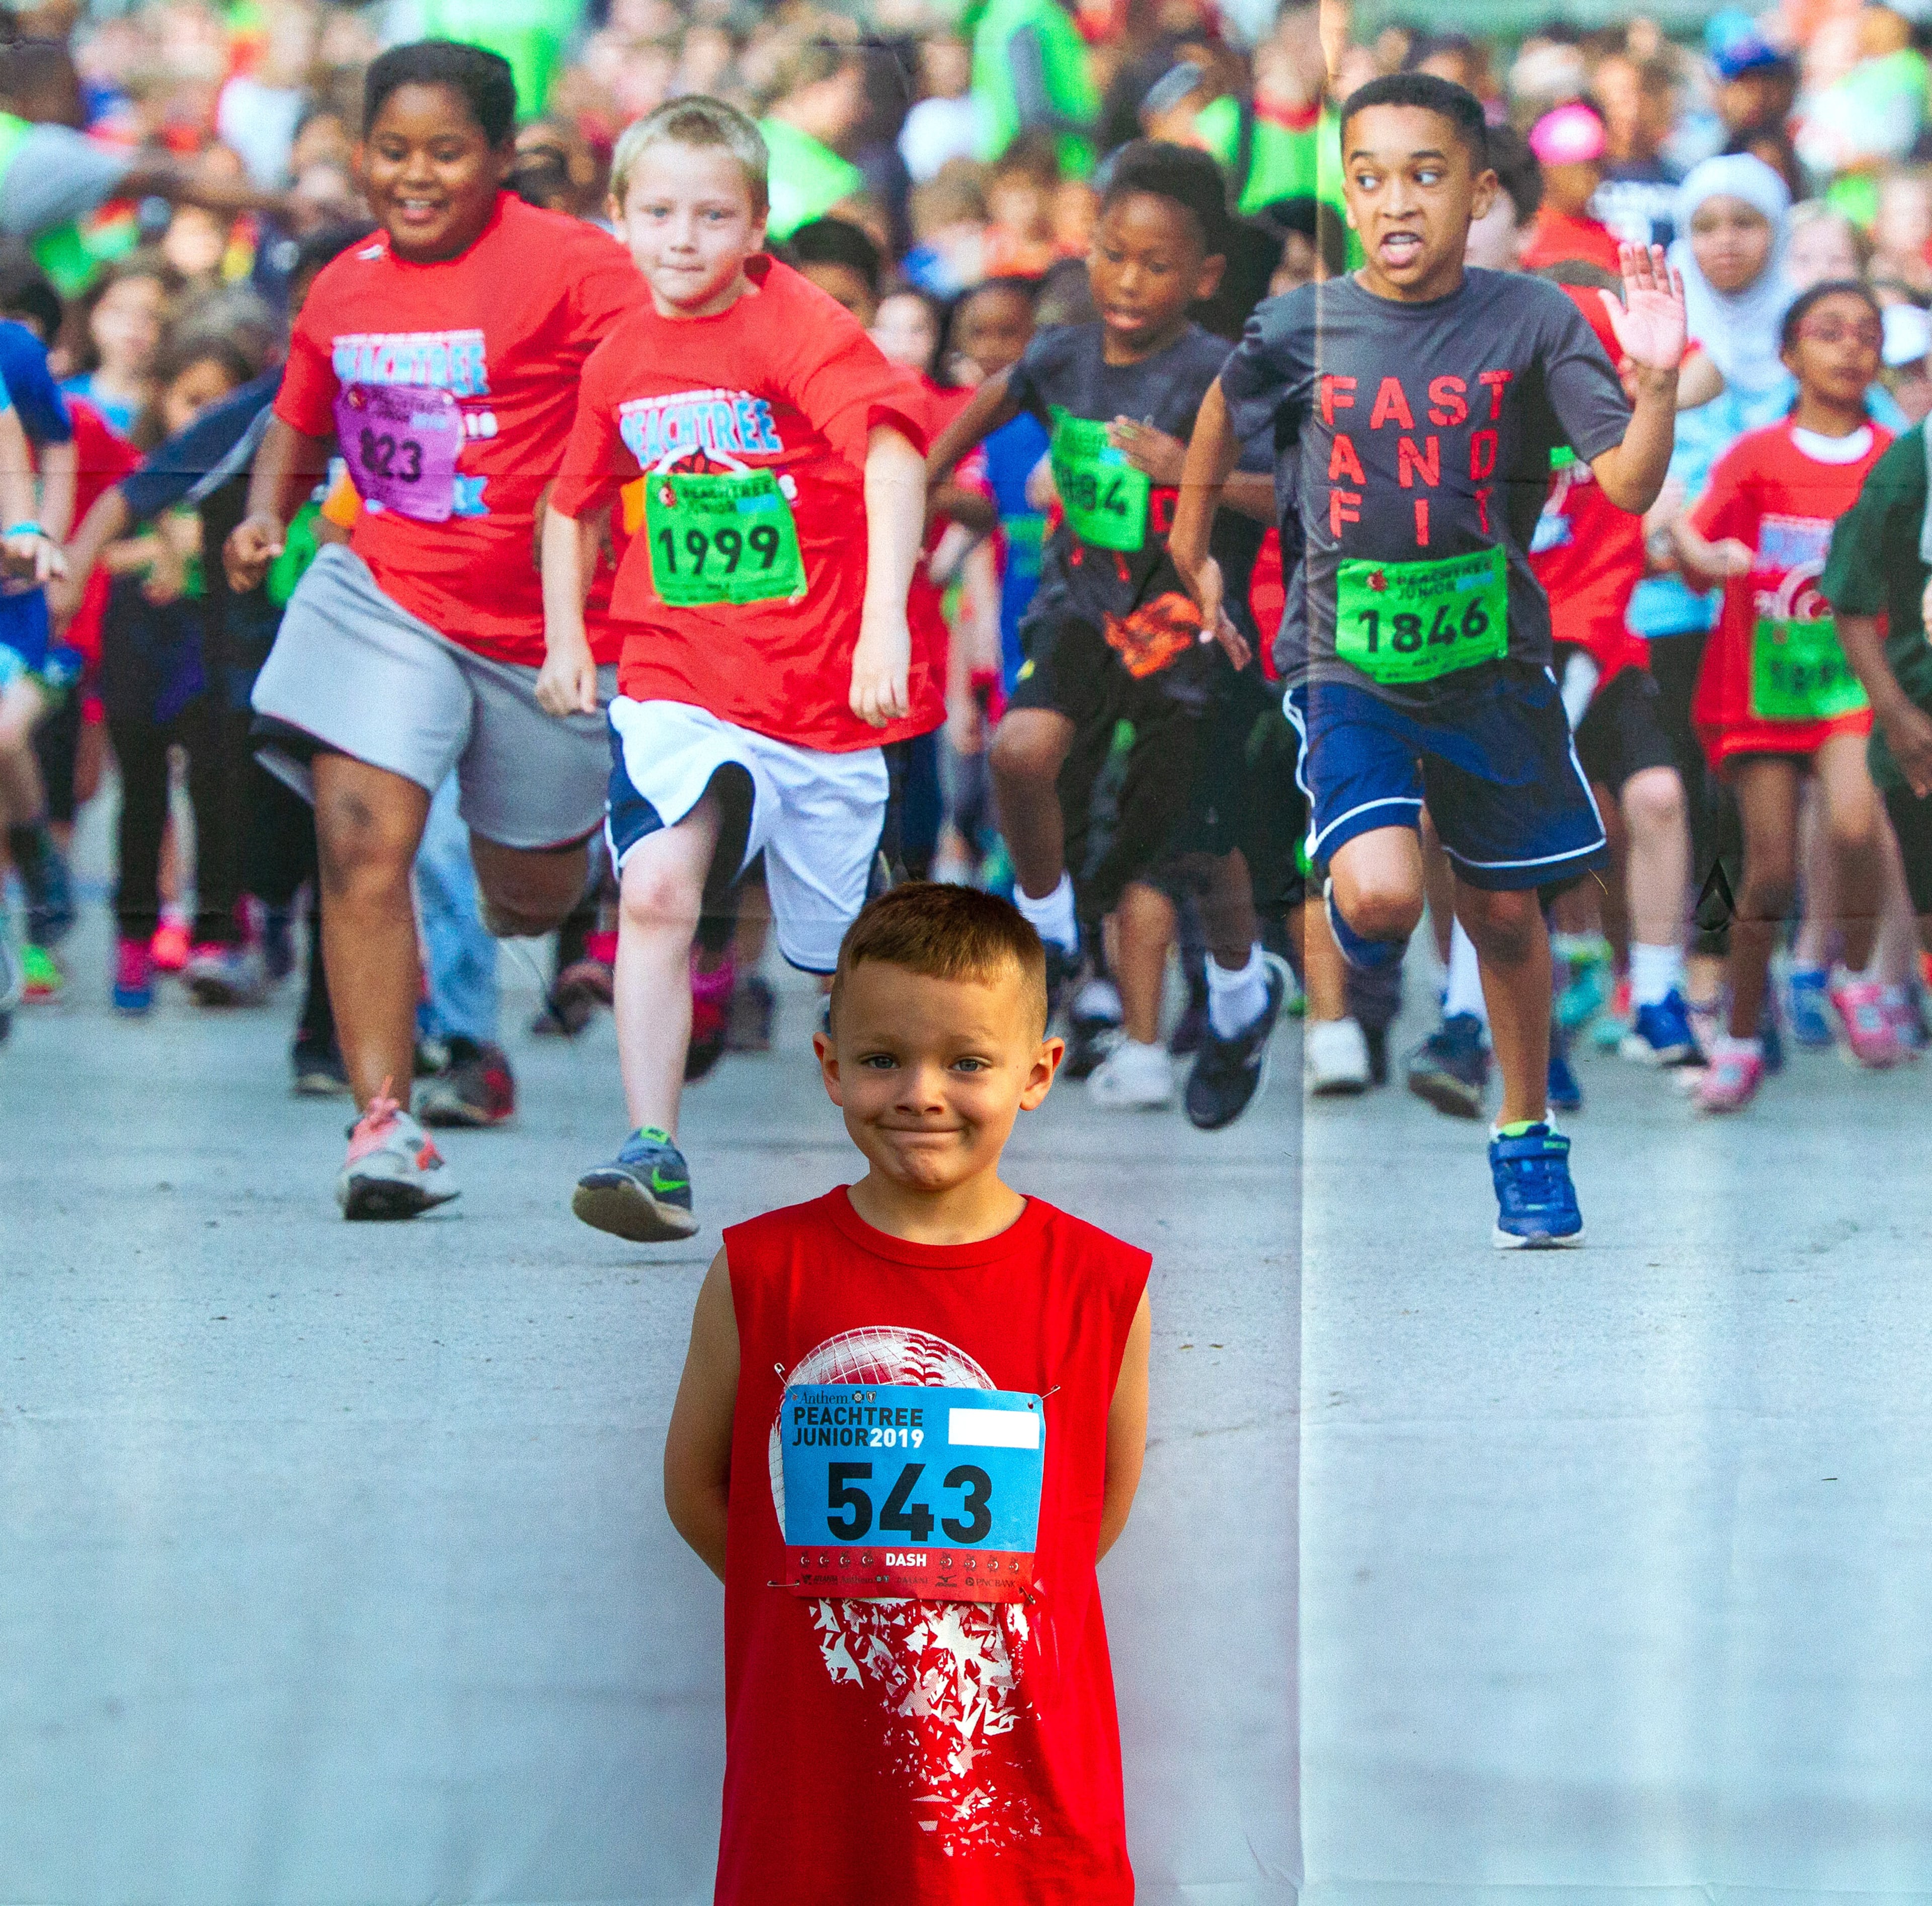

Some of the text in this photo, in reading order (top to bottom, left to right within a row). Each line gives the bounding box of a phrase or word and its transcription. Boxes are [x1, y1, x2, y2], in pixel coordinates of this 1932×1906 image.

[1321, 370, 1513, 430] FAST
[1328, 429, 1498, 488] AND
[1329, 487, 1494, 546] FIT
[659, 525, 780, 576] 1999
[1358, 596, 1489, 653] 1846
[793, 1406, 923, 1427] PEACHTREE
[799, 1390, 849, 1404] Anthem
[827, 1462, 993, 1544] 543
[886, 1553, 927, 1567] DASH
[976, 1577, 1016, 1588] PNC BANK
